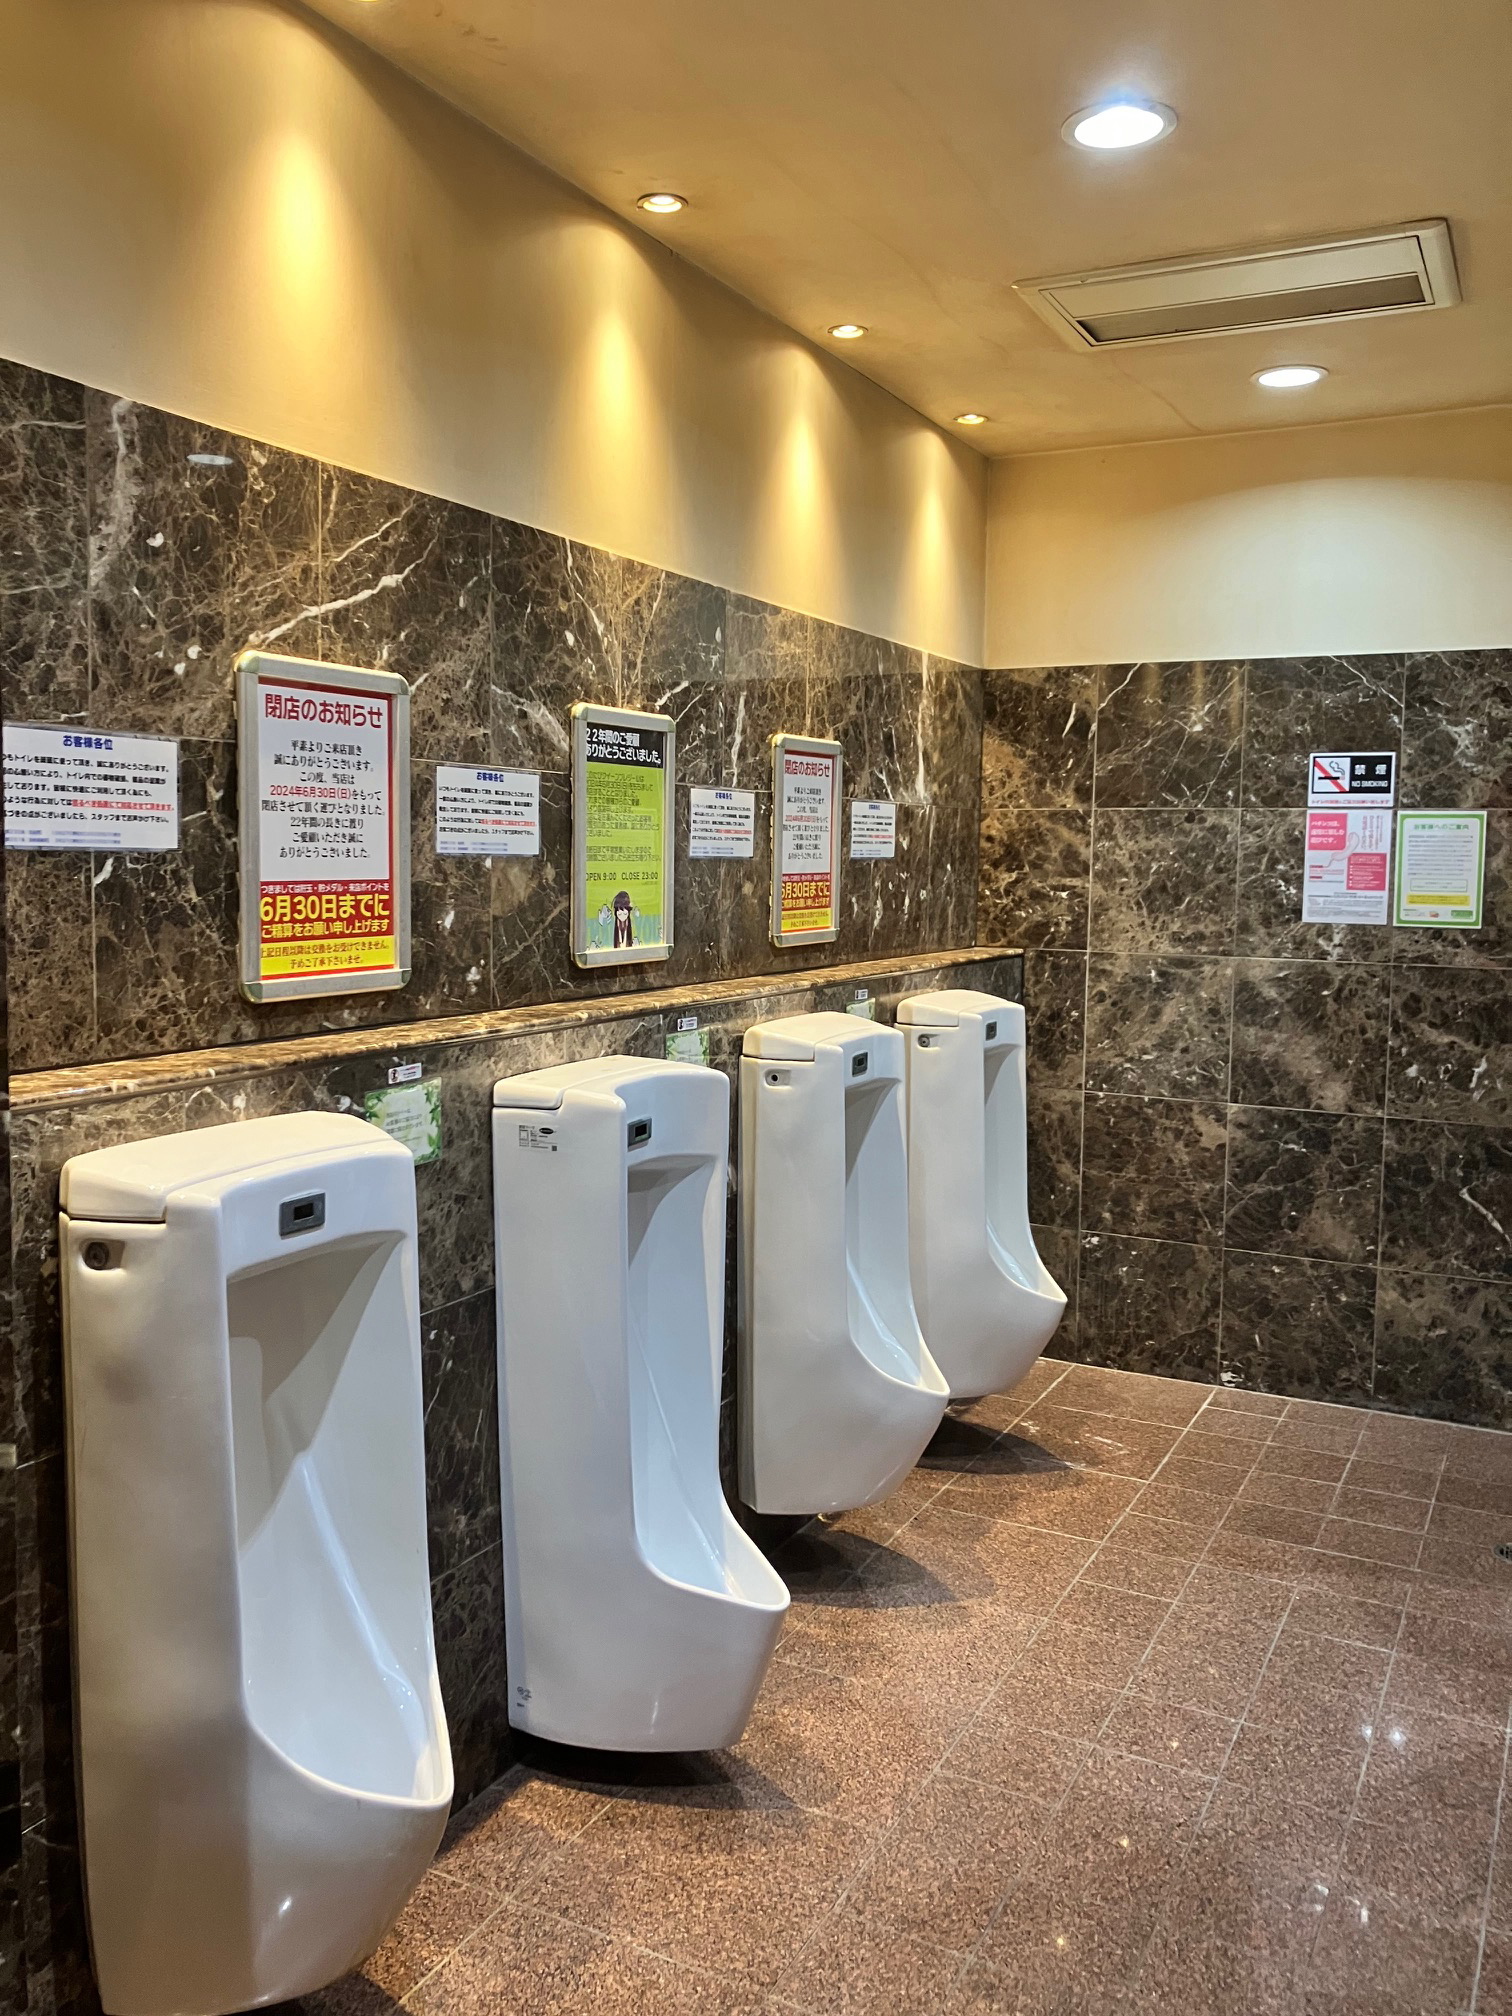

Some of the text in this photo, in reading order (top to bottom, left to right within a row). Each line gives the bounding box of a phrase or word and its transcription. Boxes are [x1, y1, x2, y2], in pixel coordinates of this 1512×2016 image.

[264, 693, 383, 729] 閉店のお知らせ
[63, 735, 113, 750] お客様各位
[273, 754, 374, 772] 誠にありがとうございます。
[784, 759, 830, 777] 閉店のお知らせ
[300, 772, 356, 785] この度、当店は
[586, 872, 659, 881] OPEN 9:00 CLOSE 23:00
[782, 881, 830, 898] 6月30日までに
[260, 893, 390, 922] 6月30日までに
[262, 919, 390, 938] ご精算をお願い申し上げます
